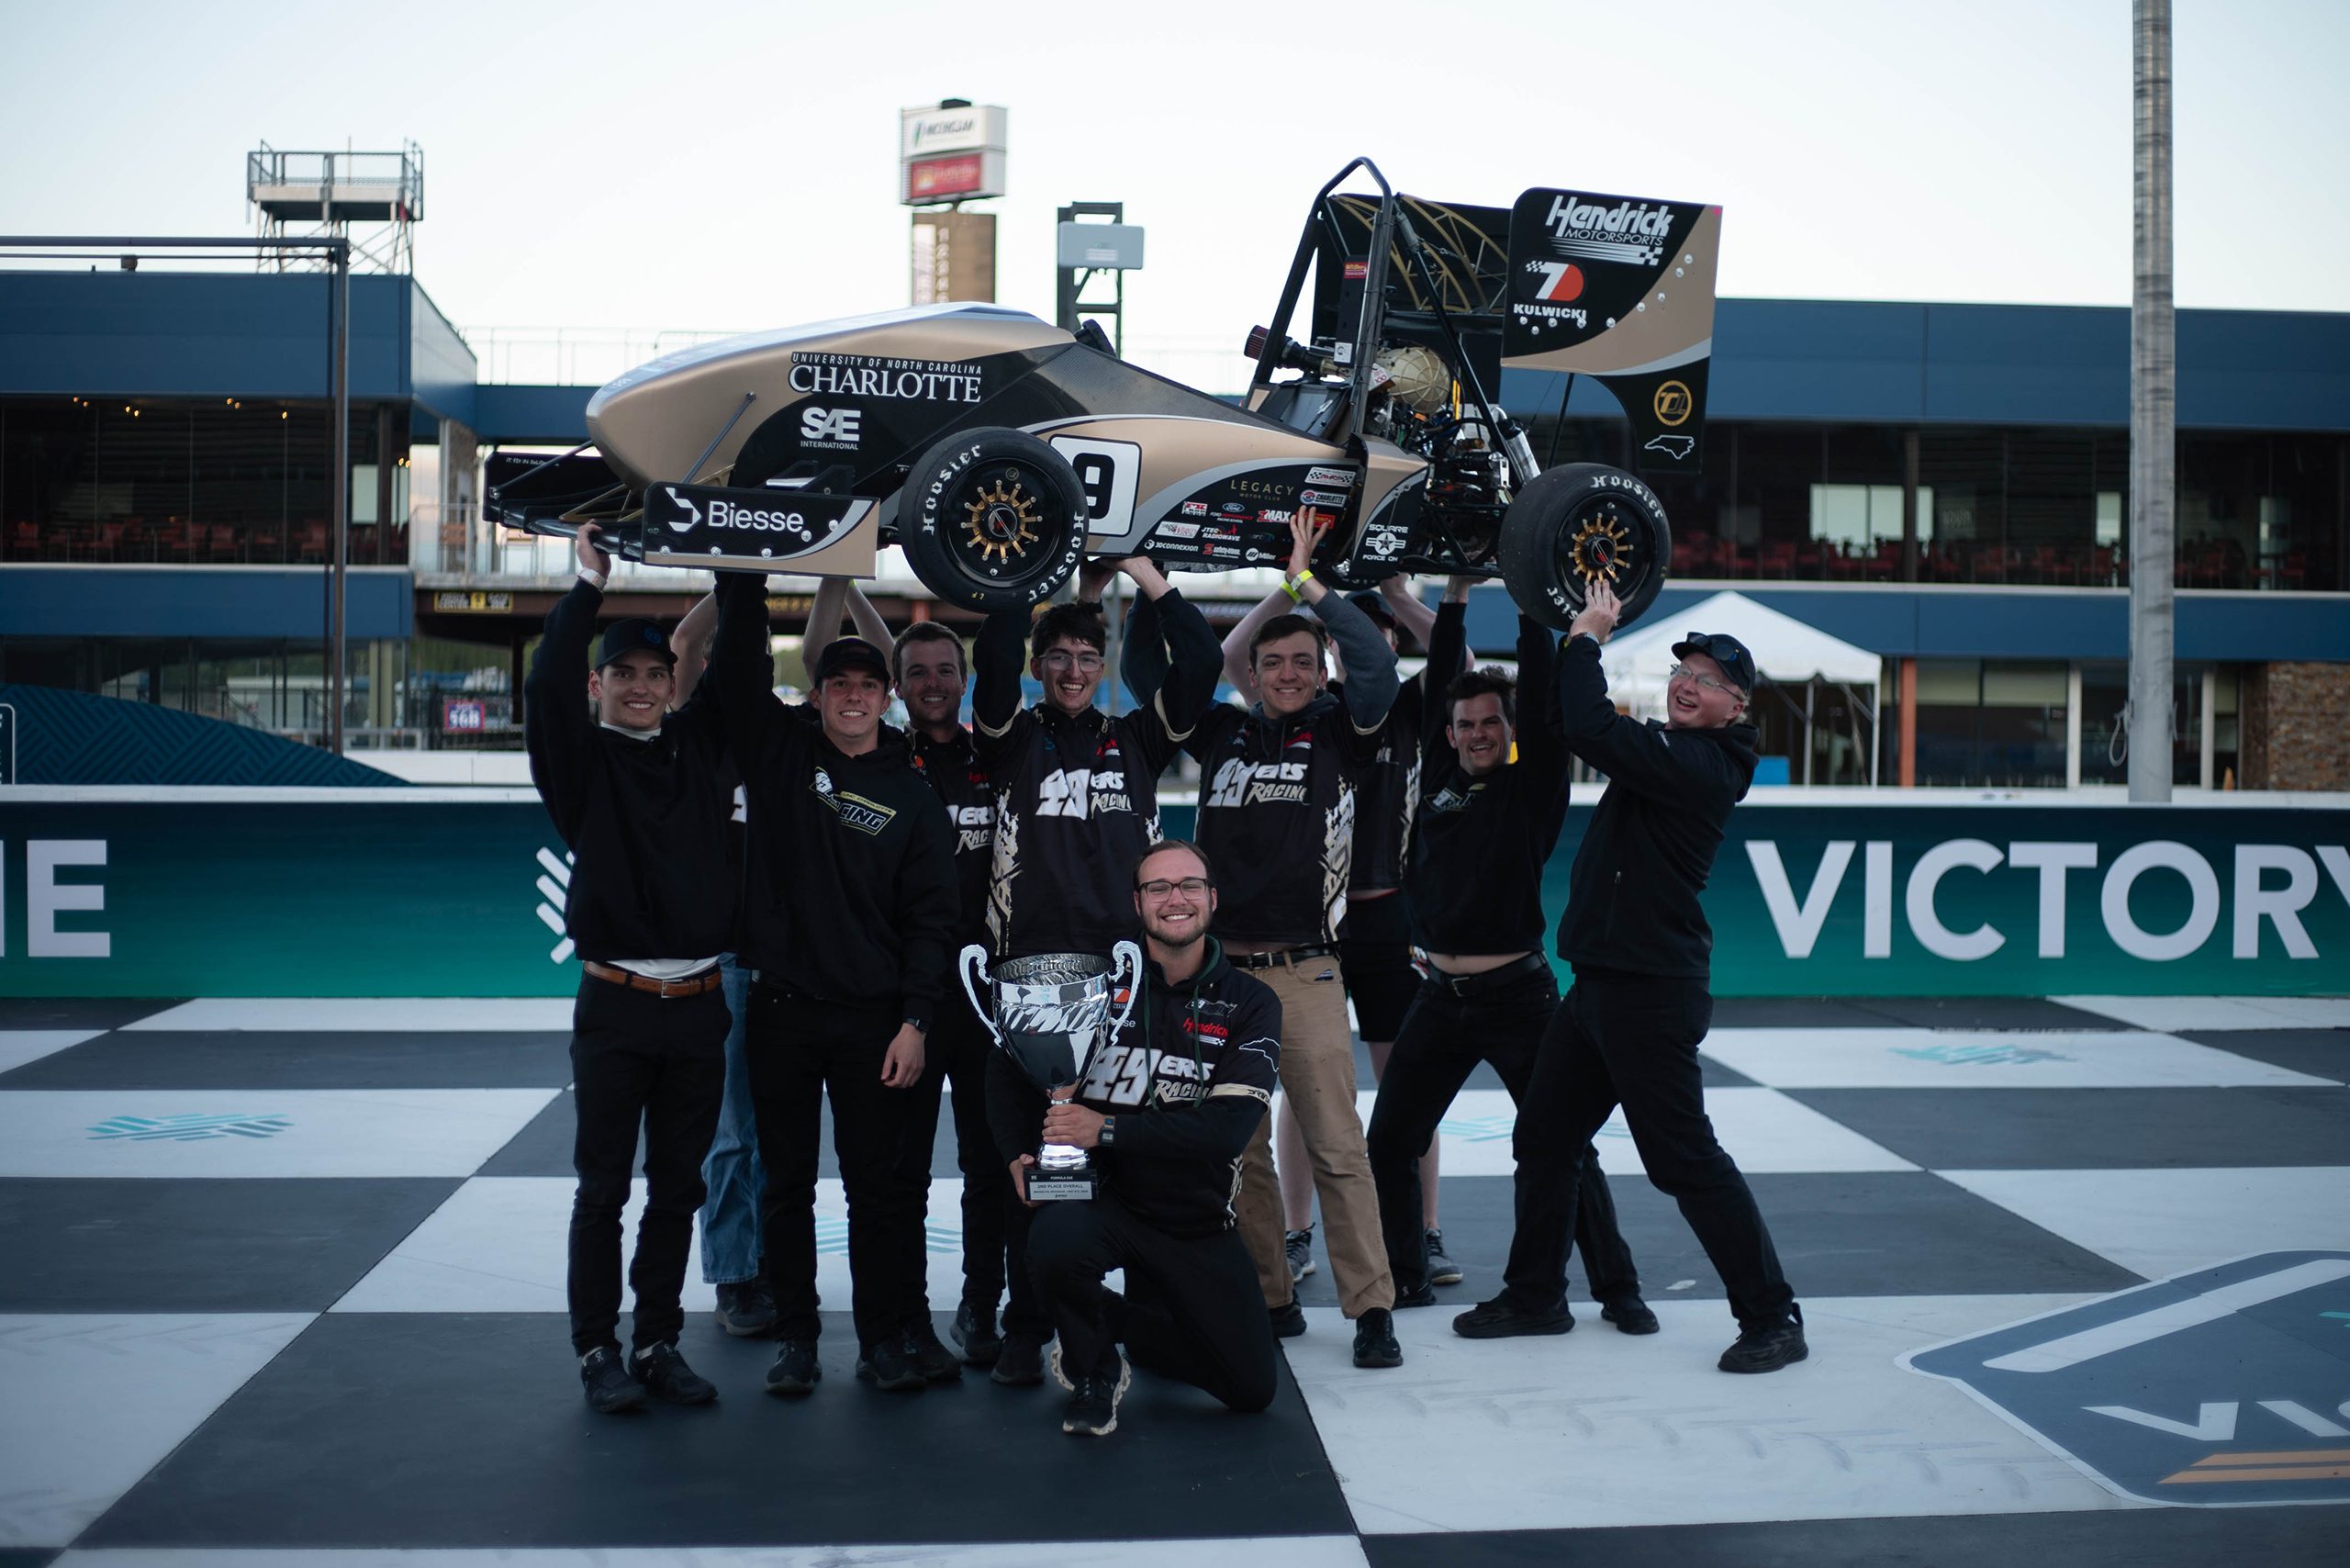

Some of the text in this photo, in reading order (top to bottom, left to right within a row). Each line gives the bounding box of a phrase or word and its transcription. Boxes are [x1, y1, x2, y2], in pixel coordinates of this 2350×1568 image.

[1545, 195, 1675, 237] Hendrick
[1564, 229, 1663, 247] MOTORSPORTS
[1514, 304, 1587, 319] KULWICKI
[792, 353, 982, 375] UNIVERSITY OF NORTH CAROLINA
[789, 364, 982, 403] CHARLOTTE
[800, 407, 862, 442] SAE
[800, 440, 859, 451] INTERNATIONAL
[1230, 479, 1295, 496] LEGACY
[708, 499, 804, 533] Biesse
[1202, 532, 1241, 542] RADIOWAVE
[1368, 523, 1409, 534] SQUARE
[1362, 554, 1386, 562] FORCE
[1547, 587, 1580, 620] sier
[955, 830, 994, 855] RAC
[0, 839, 110, 957] E
[1182, 1016, 1228, 1037] Hndrick
